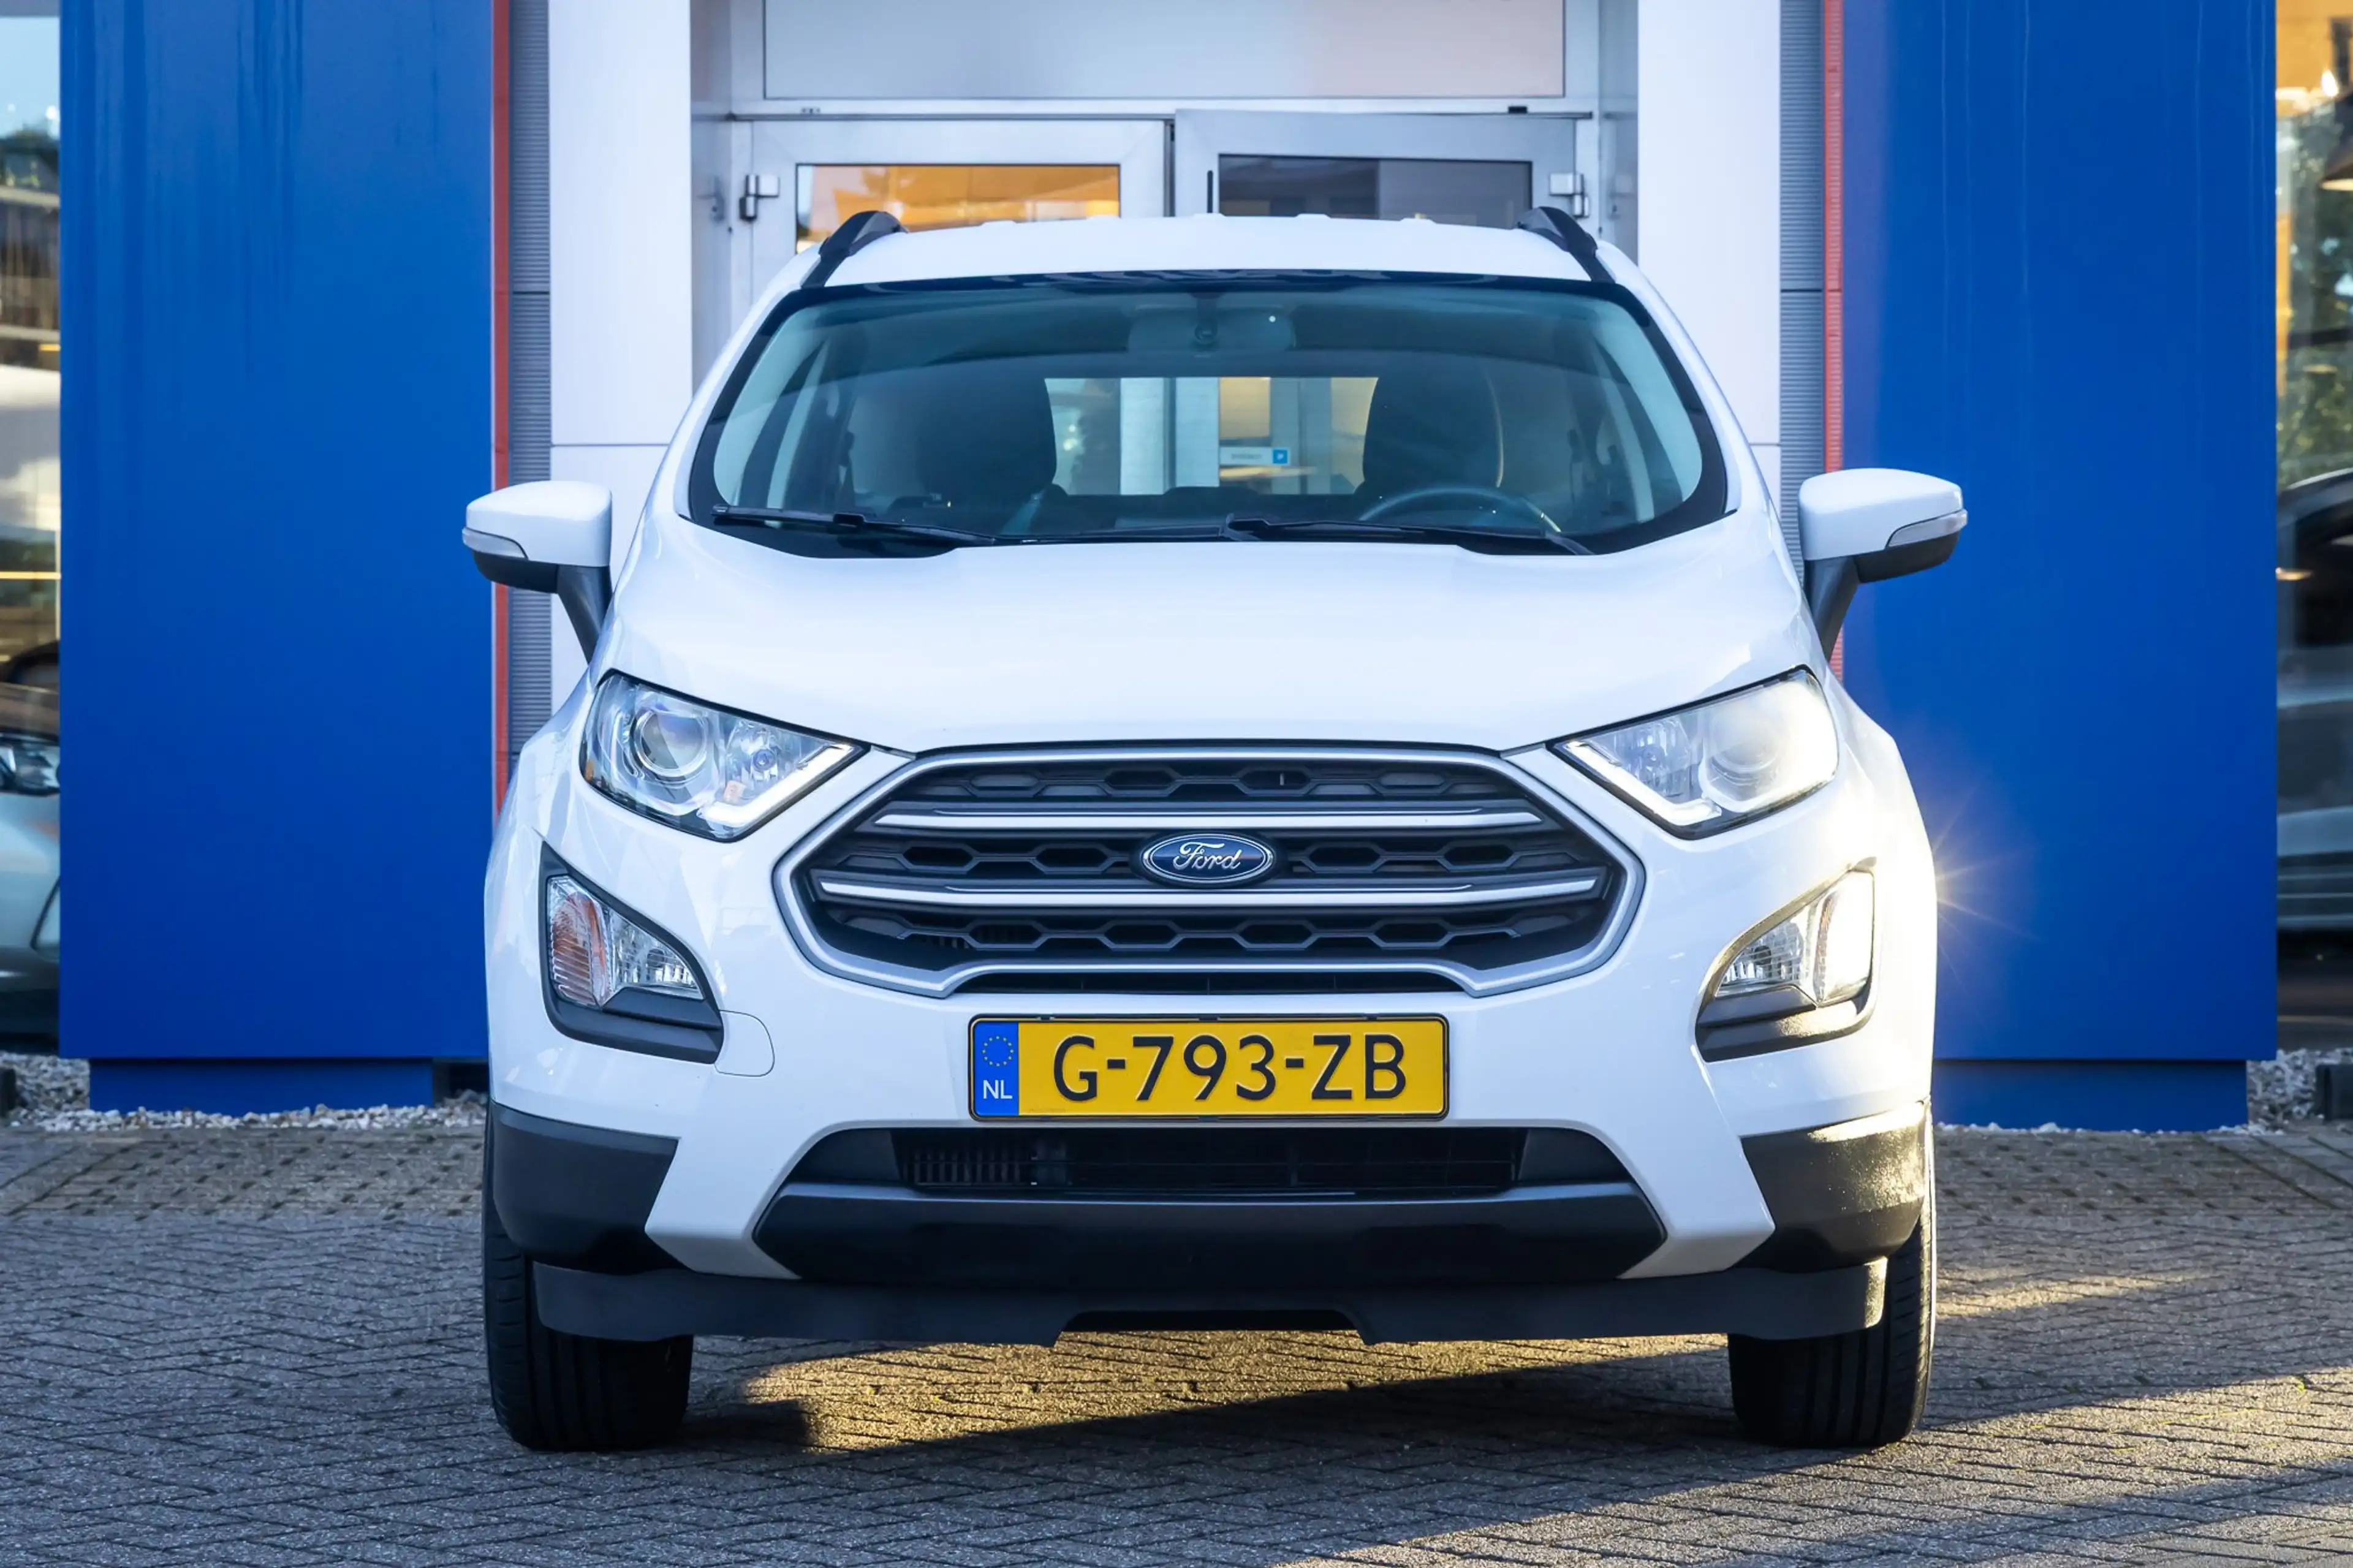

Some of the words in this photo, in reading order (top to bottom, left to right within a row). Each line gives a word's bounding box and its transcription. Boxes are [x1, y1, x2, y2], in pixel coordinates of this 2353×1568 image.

[1173, 841, 1242, 870] Ford
[1053, 1034, 1406, 1102] G-793-ZB
[983, 1080, 1013, 1099] NL
